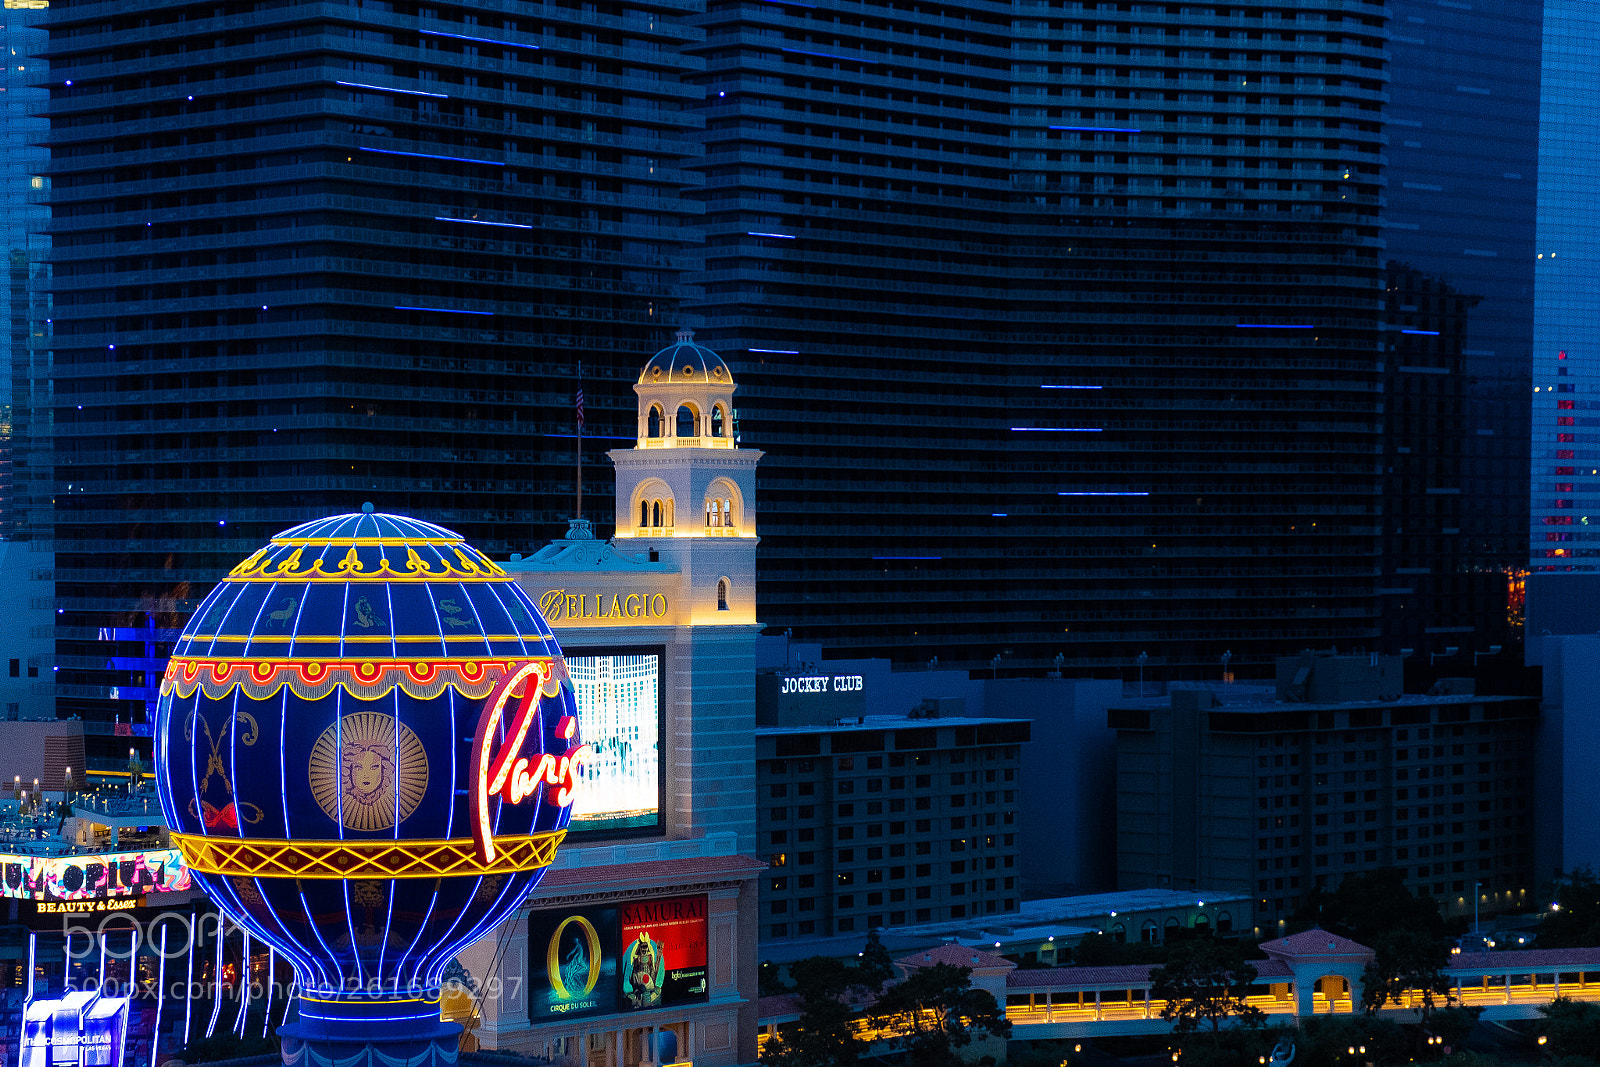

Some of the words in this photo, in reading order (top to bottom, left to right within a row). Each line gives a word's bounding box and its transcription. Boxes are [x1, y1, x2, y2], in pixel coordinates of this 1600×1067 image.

[540, 589, 668, 621] BELLAGIO
[781, 677, 829, 694] JOCKEY
[833, 676, 863, 692] CLUB
[471, 662, 592, 863] Paris
[62, 860, 165, 893] OPIUM
[37, 901, 95, 913] BEAUTY
[97, 901, 105, 911] &
[106, 898, 137, 911] Essex
[623, 900, 704, 925] SAMURAI
[550, 1003, 570, 1013] CIRQUE
[45, 1035, 112, 1046] COSMOPOLITAN
